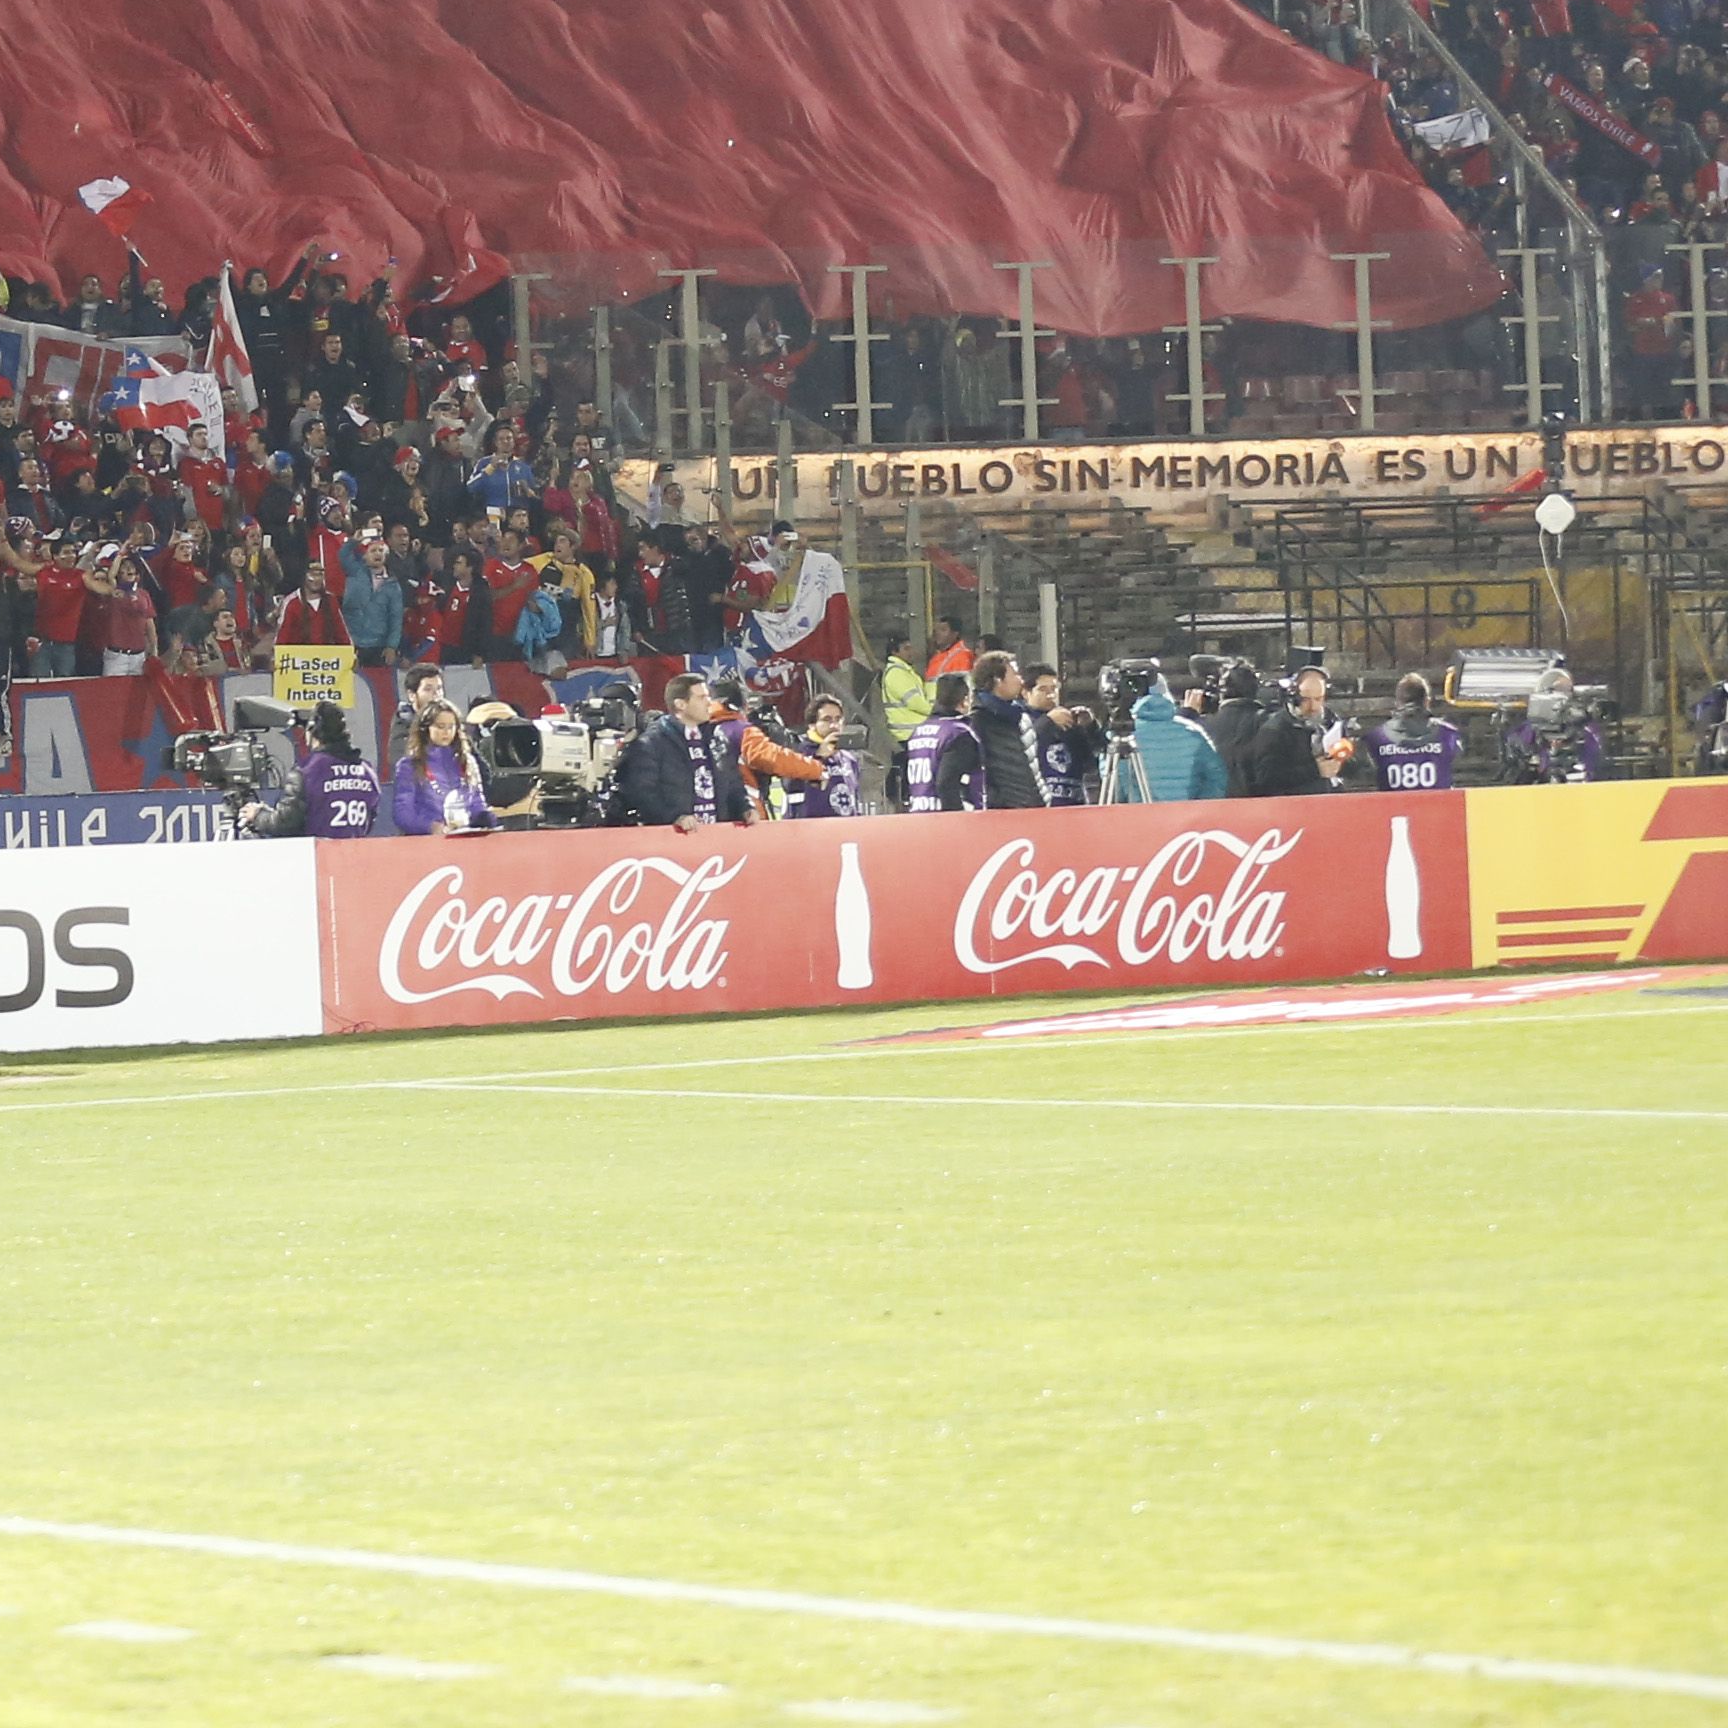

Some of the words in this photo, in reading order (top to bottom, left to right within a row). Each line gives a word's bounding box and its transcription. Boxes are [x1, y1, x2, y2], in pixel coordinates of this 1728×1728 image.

[1559, 84, 1601, 123] VAMOS
[1600, 117, 1638, 147] CHILE
[1034, 459, 1111, 494] SIN
[1130, 452, 1351, 490] MEMORIA
[1375, 448, 1428, 484] ES
[1444, 445, 1519, 481] UN
[1566, 439, 1726, 478] UEBLO
[278, 653, 341, 675] #LaSed
[301, 672, 337, 686] Esta
[286, 687, 343, 703] Intacta
[330, 764, 348, 777] TV
[1386, 761, 1438, 790] 080
[329, 799, 368, 828] 269
[952, 824, 1306, 974] Coca-Cola
[377, 853, 748, 1005] Coca-Cola
